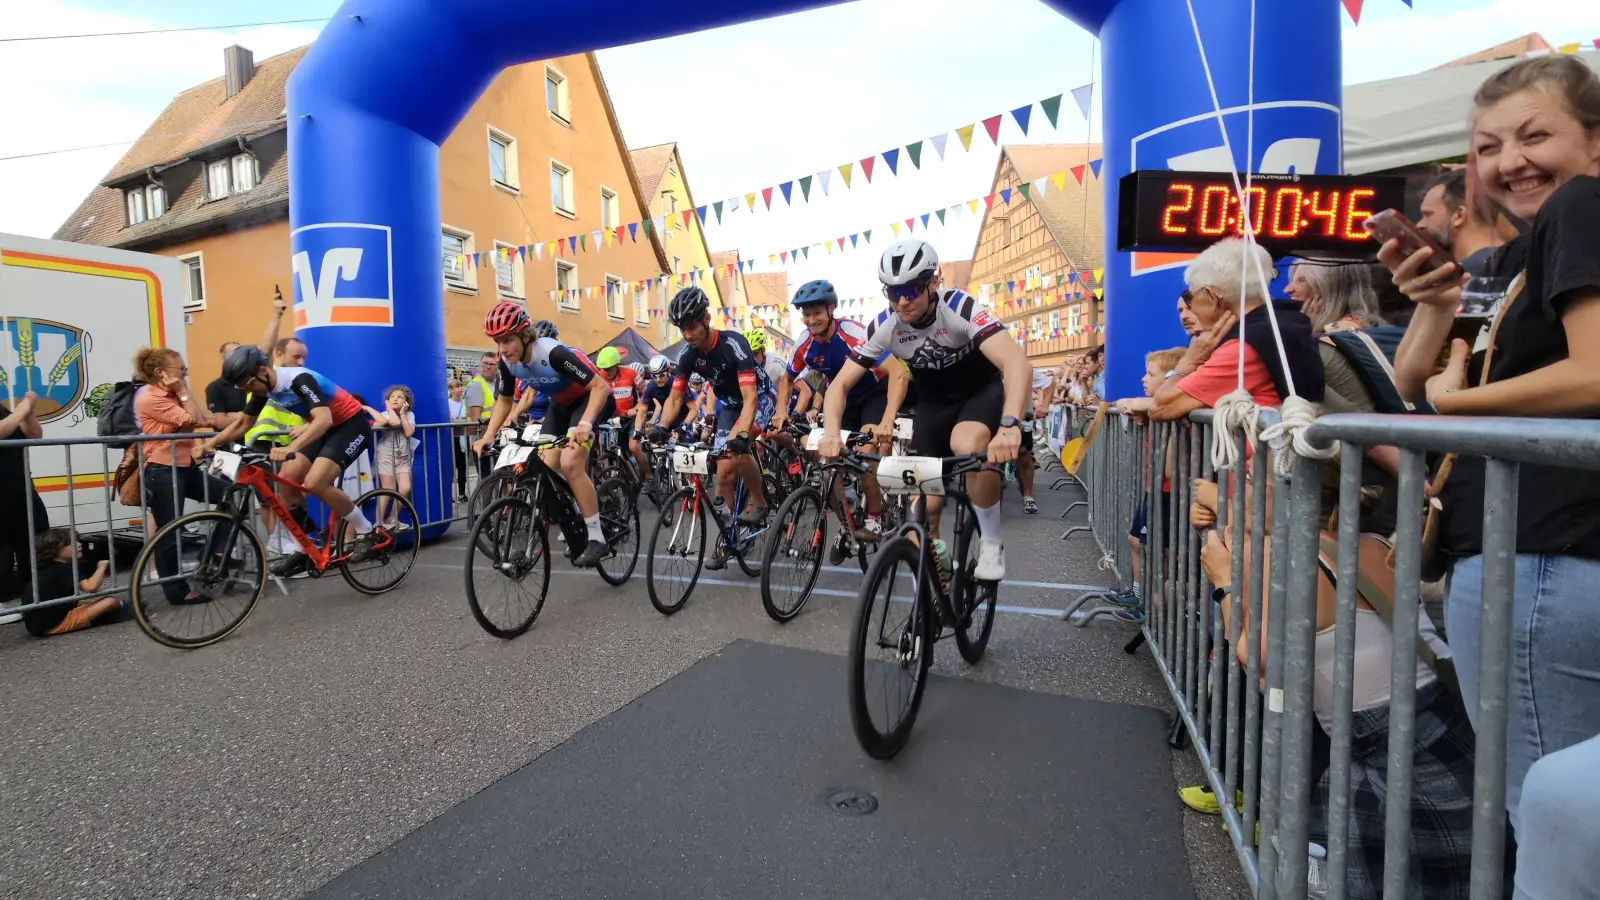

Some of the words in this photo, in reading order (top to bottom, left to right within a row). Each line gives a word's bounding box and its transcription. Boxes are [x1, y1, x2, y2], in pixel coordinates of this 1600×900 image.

[1163, 183, 1375, 240] 20:00:46
[899, 334, 919, 344] UVEX
[563, 360, 588, 380] radhaus
[521, 375, 560, 385] adhaus
[344, 433, 365, 456] radhaus
[682, 453, 696, 466] 31
[902, 469, 917, 486] 6
